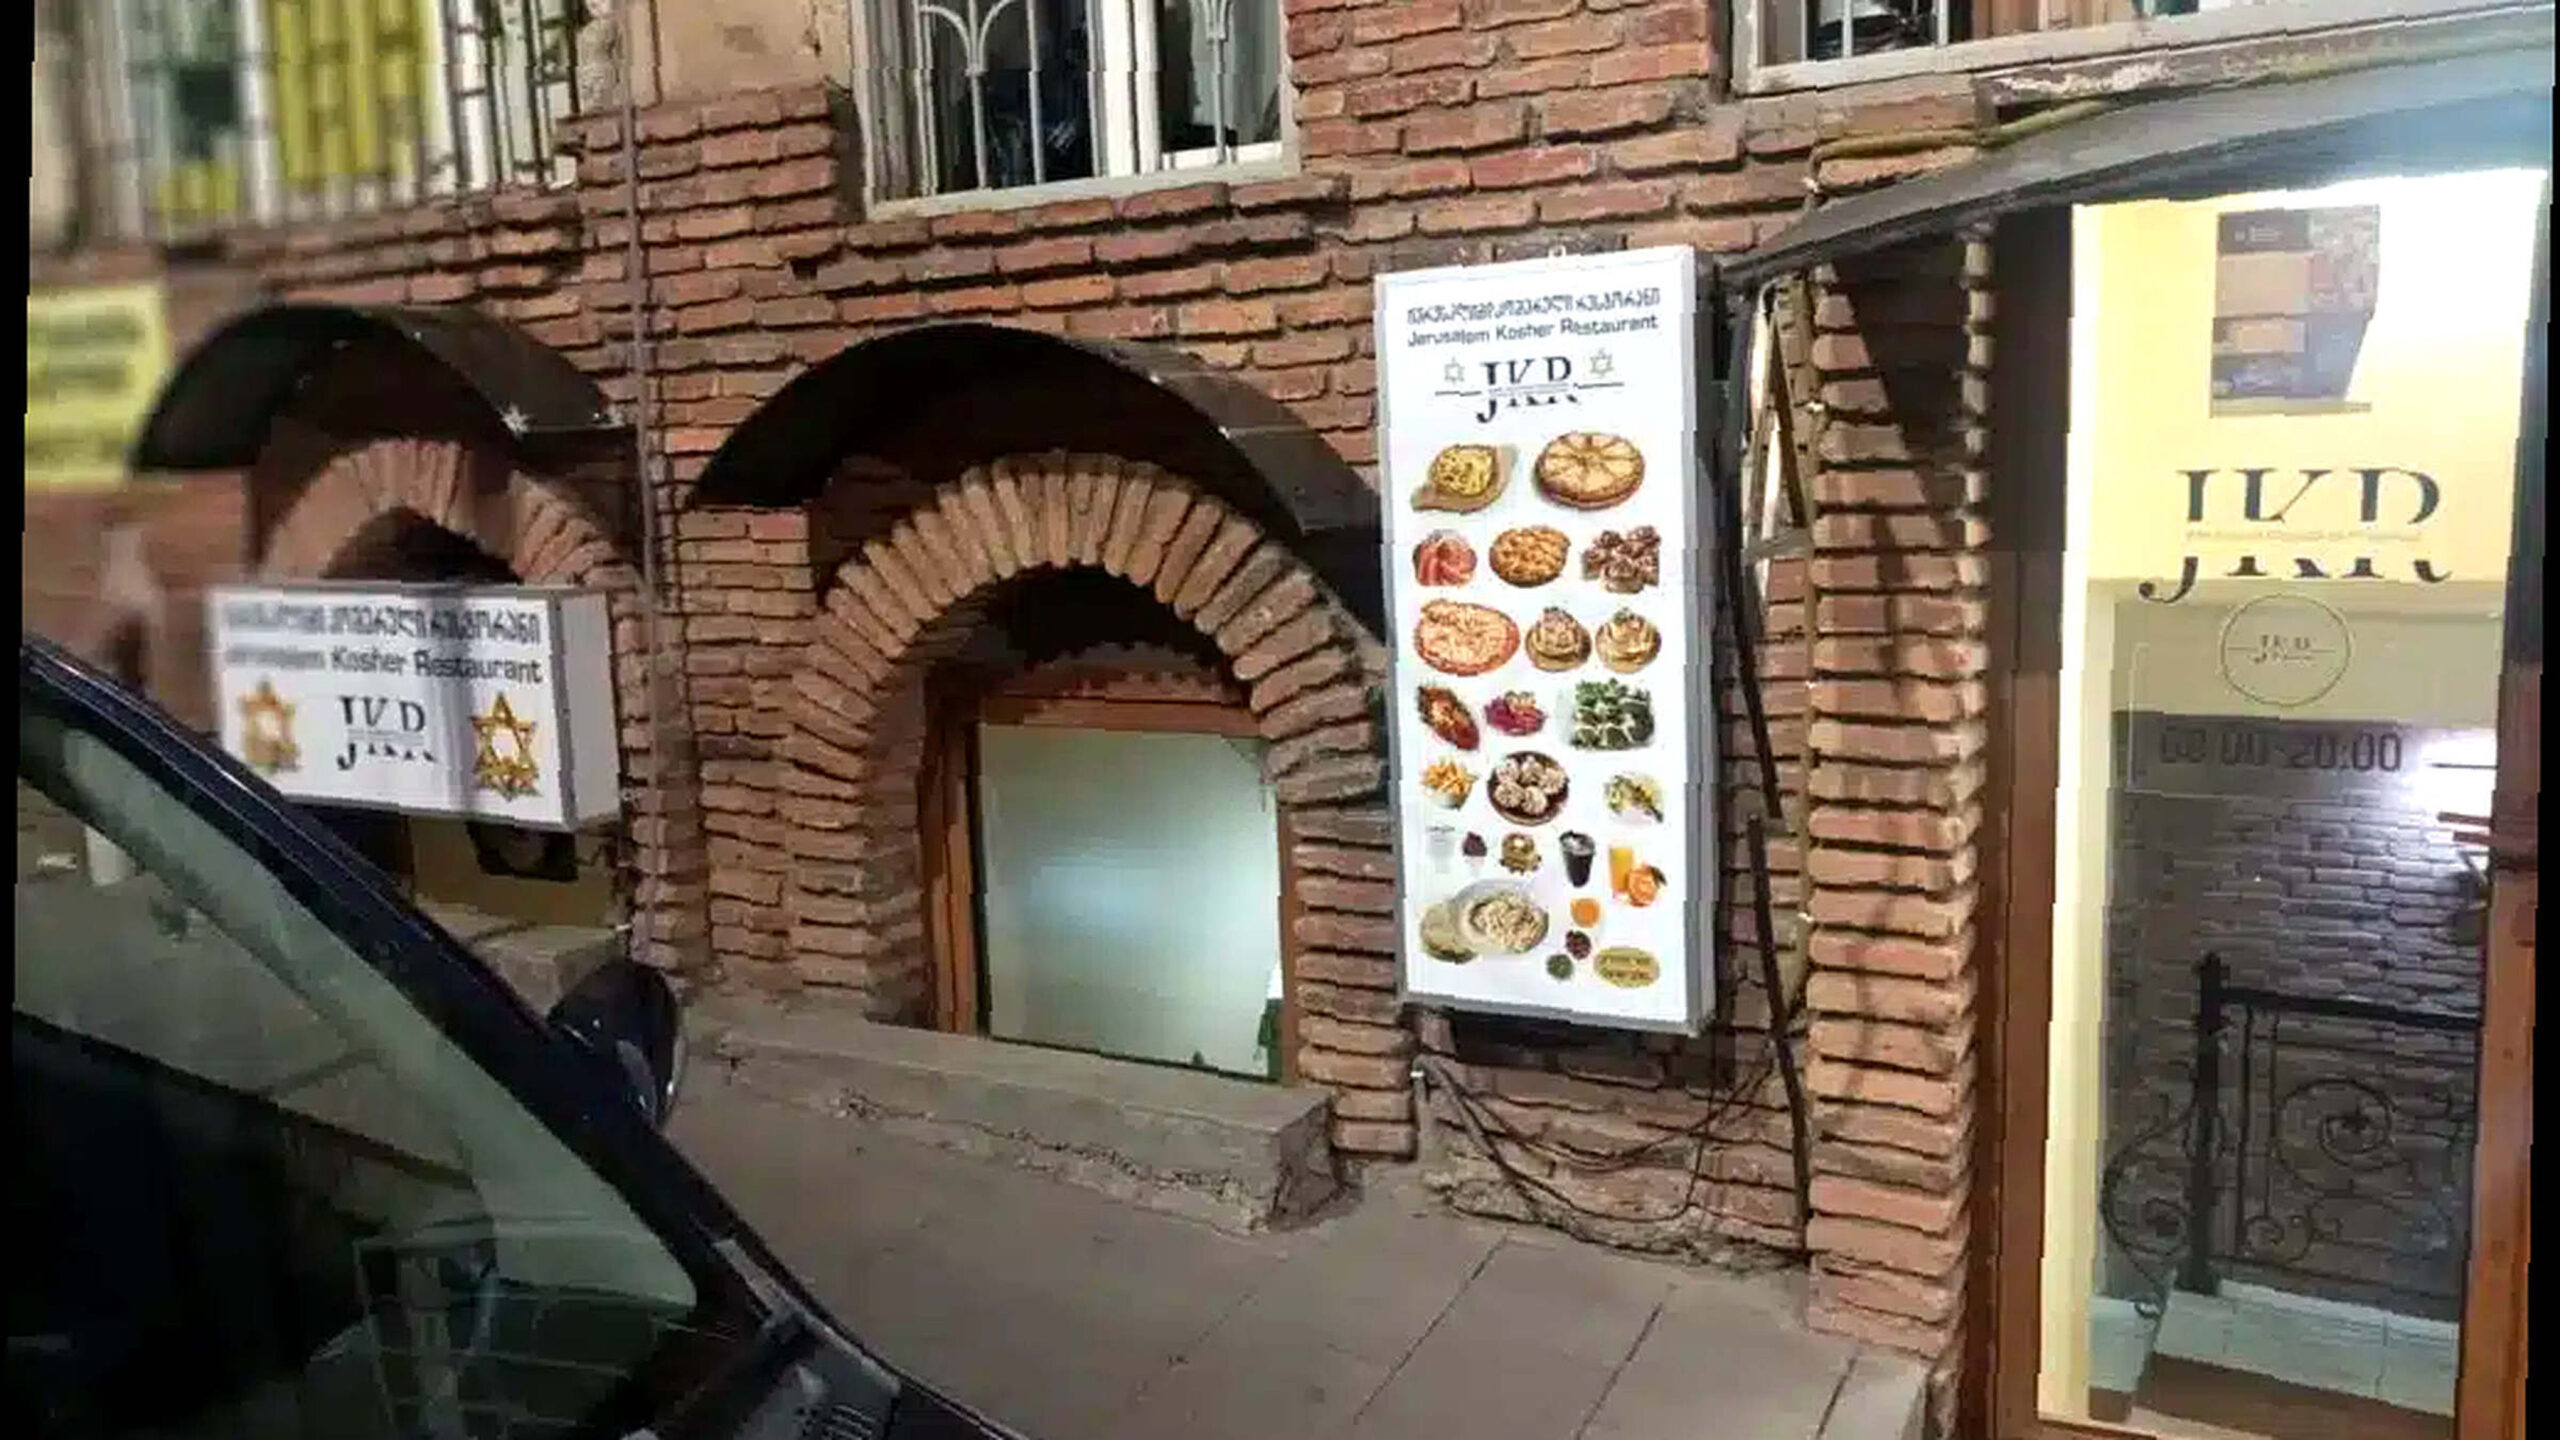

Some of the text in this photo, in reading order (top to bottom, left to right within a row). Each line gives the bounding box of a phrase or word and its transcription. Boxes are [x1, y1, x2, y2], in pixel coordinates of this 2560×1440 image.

[1407, 314, 1659, 347] Jerusalem Kosher Restaurant
[1475, 355, 1584, 423] JKR
[2138, 467, 2454, 604] JKR
[331, 645, 409, 677] Kosher
[414, 650, 544, 684] Restaurant
